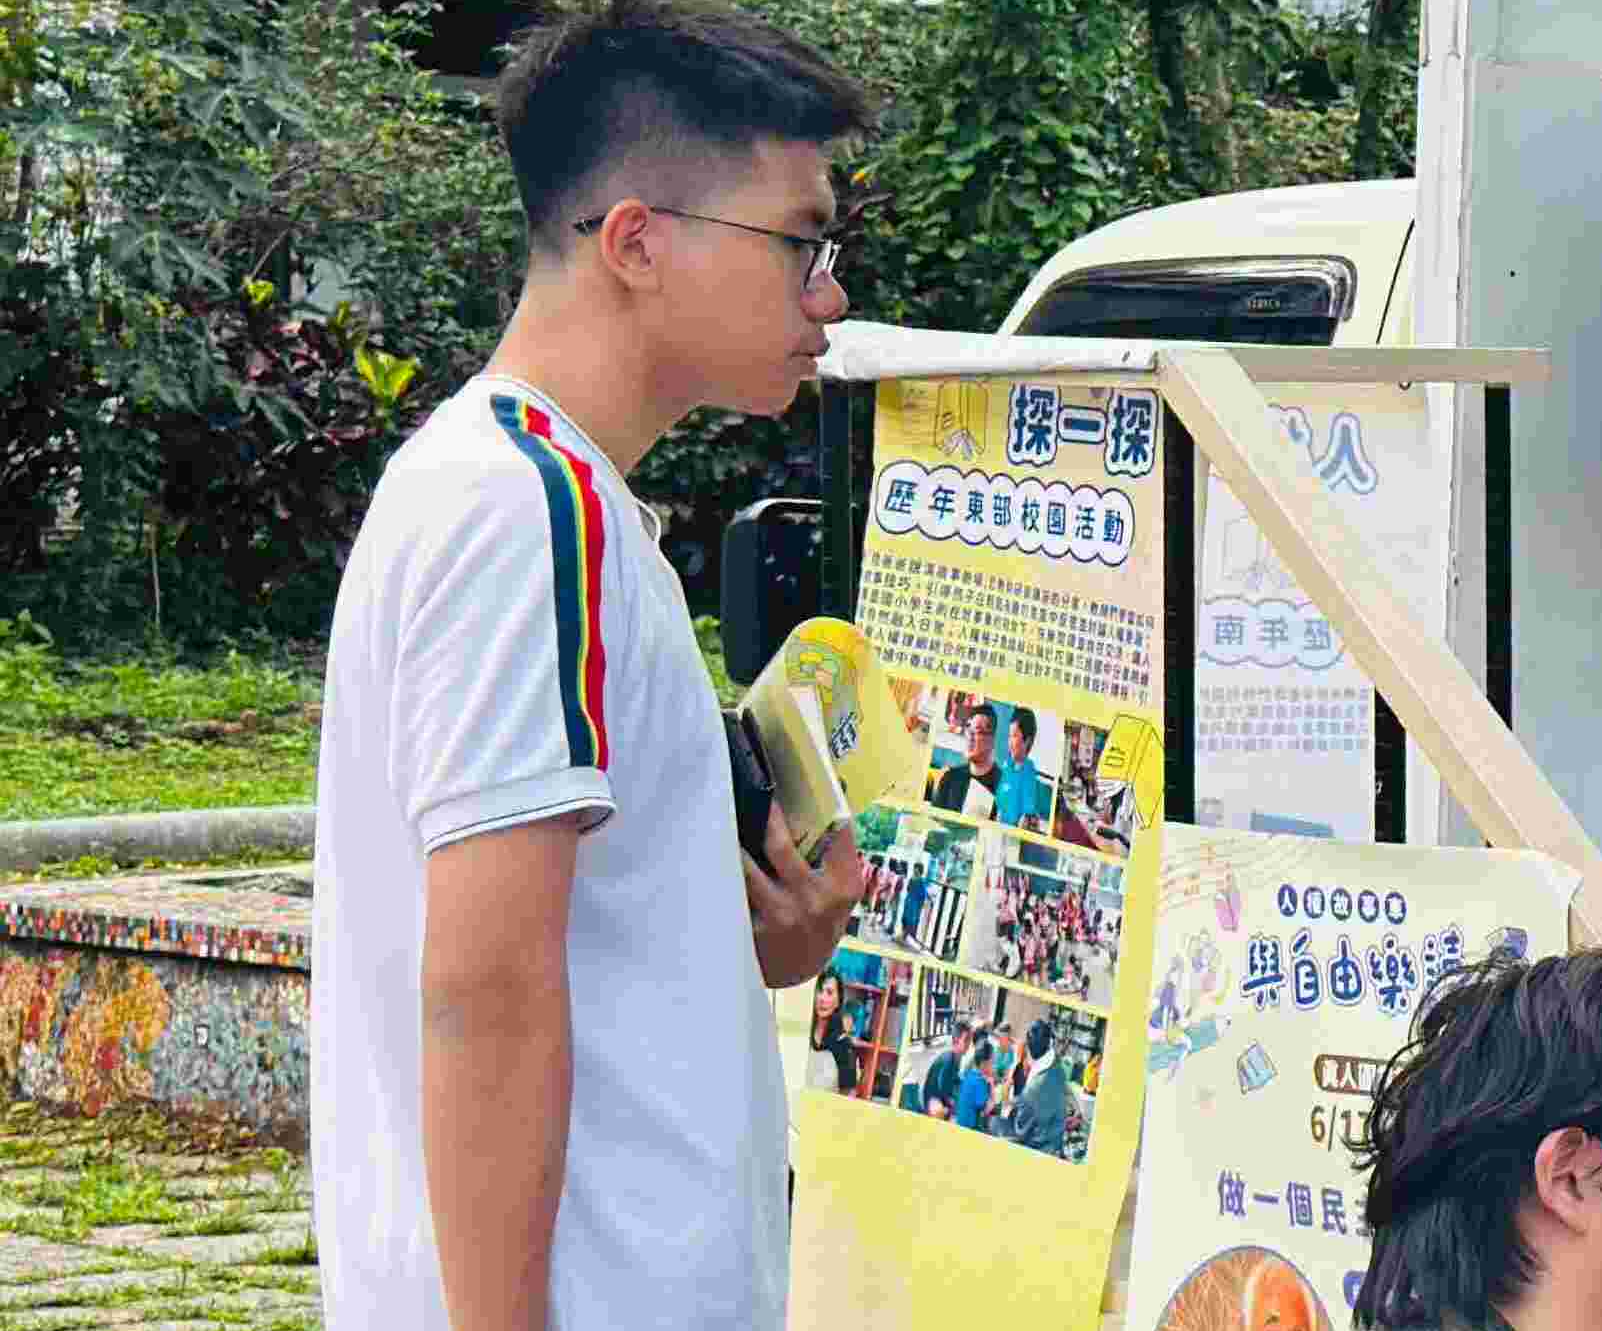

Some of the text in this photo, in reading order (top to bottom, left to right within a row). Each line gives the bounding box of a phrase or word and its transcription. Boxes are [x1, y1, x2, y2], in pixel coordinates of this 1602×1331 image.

[1009, 383, 1155, 472] 探一探
[884, 478, 1125, 545] 歷年東部校園活動
